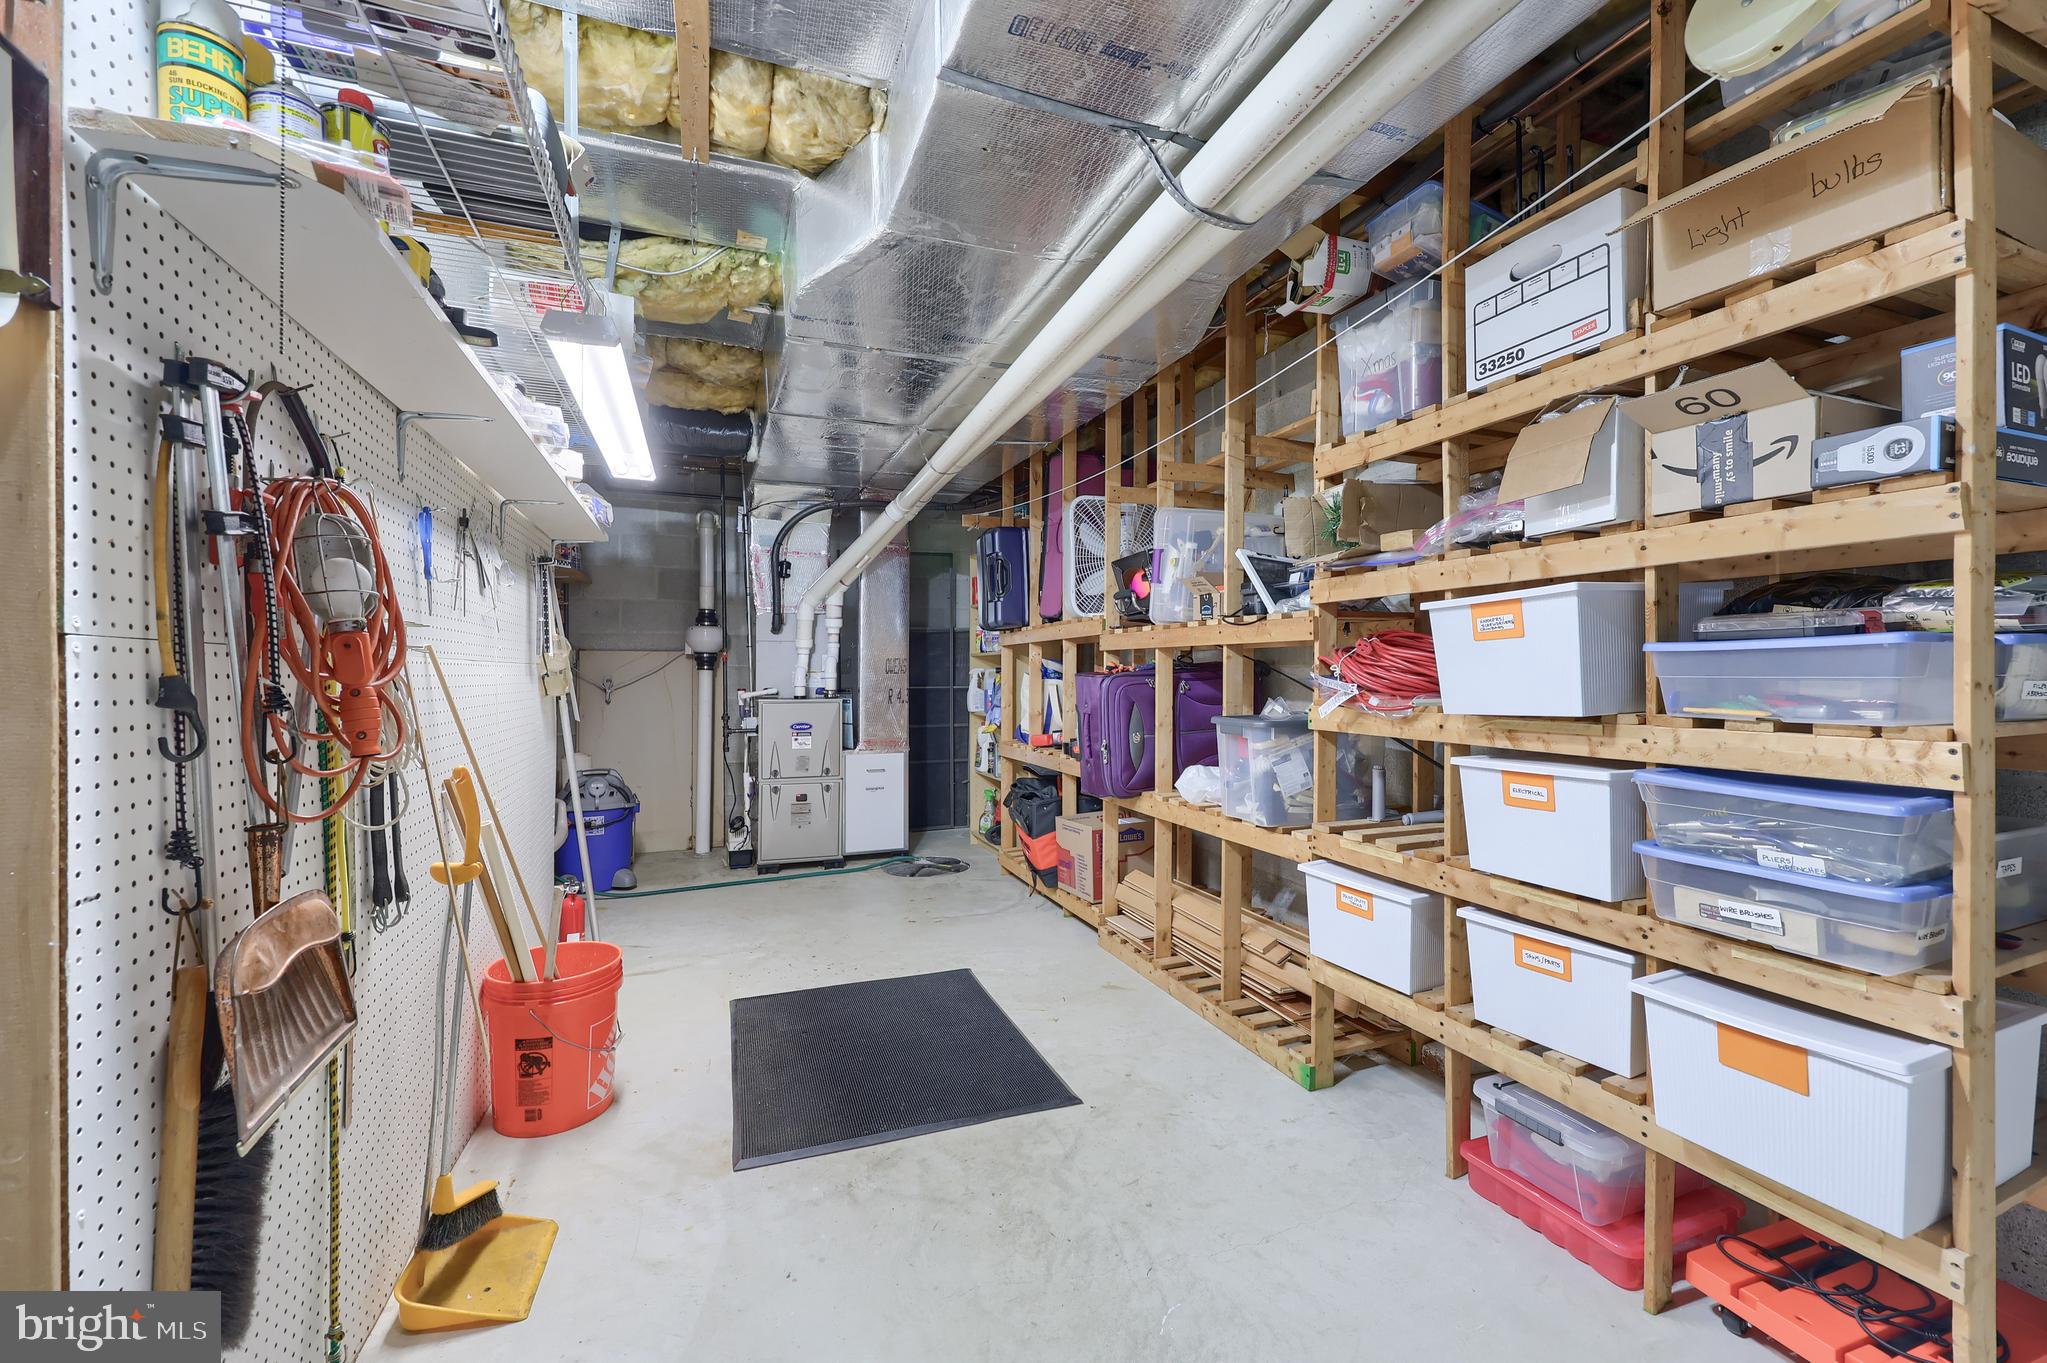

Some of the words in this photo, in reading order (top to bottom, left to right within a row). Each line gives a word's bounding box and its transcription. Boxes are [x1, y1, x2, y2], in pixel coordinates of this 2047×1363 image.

[166, 36, 238, 82] BEHR
[168, 76, 183, 84] SUN
[186, 78, 228, 99] BLOCKING
[1688, 207, 1750, 250] Light
[1812, 152, 1883, 198] bulbs
[1573, 322, 1597, 337] STAPLES
[1361, 351, 1397, 377] Xmas
[1478, 347, 1526, 376] 33250
[2012, 361, 2031, 384] LED
[1675, 388, 1741, 415] 60
[1722, 429, 1733, 457] smile
[1725, 458, 1734, 471] to
[2006, 452, 2039, 467] enhance
[1120, 832, 1143, 841] LOWE'S
[1777, 863, 1825, 876] WRENCHES
[1719, 906, 1738, 915] WIRE
[1739, 909, 1775, 920] BRUSHES
